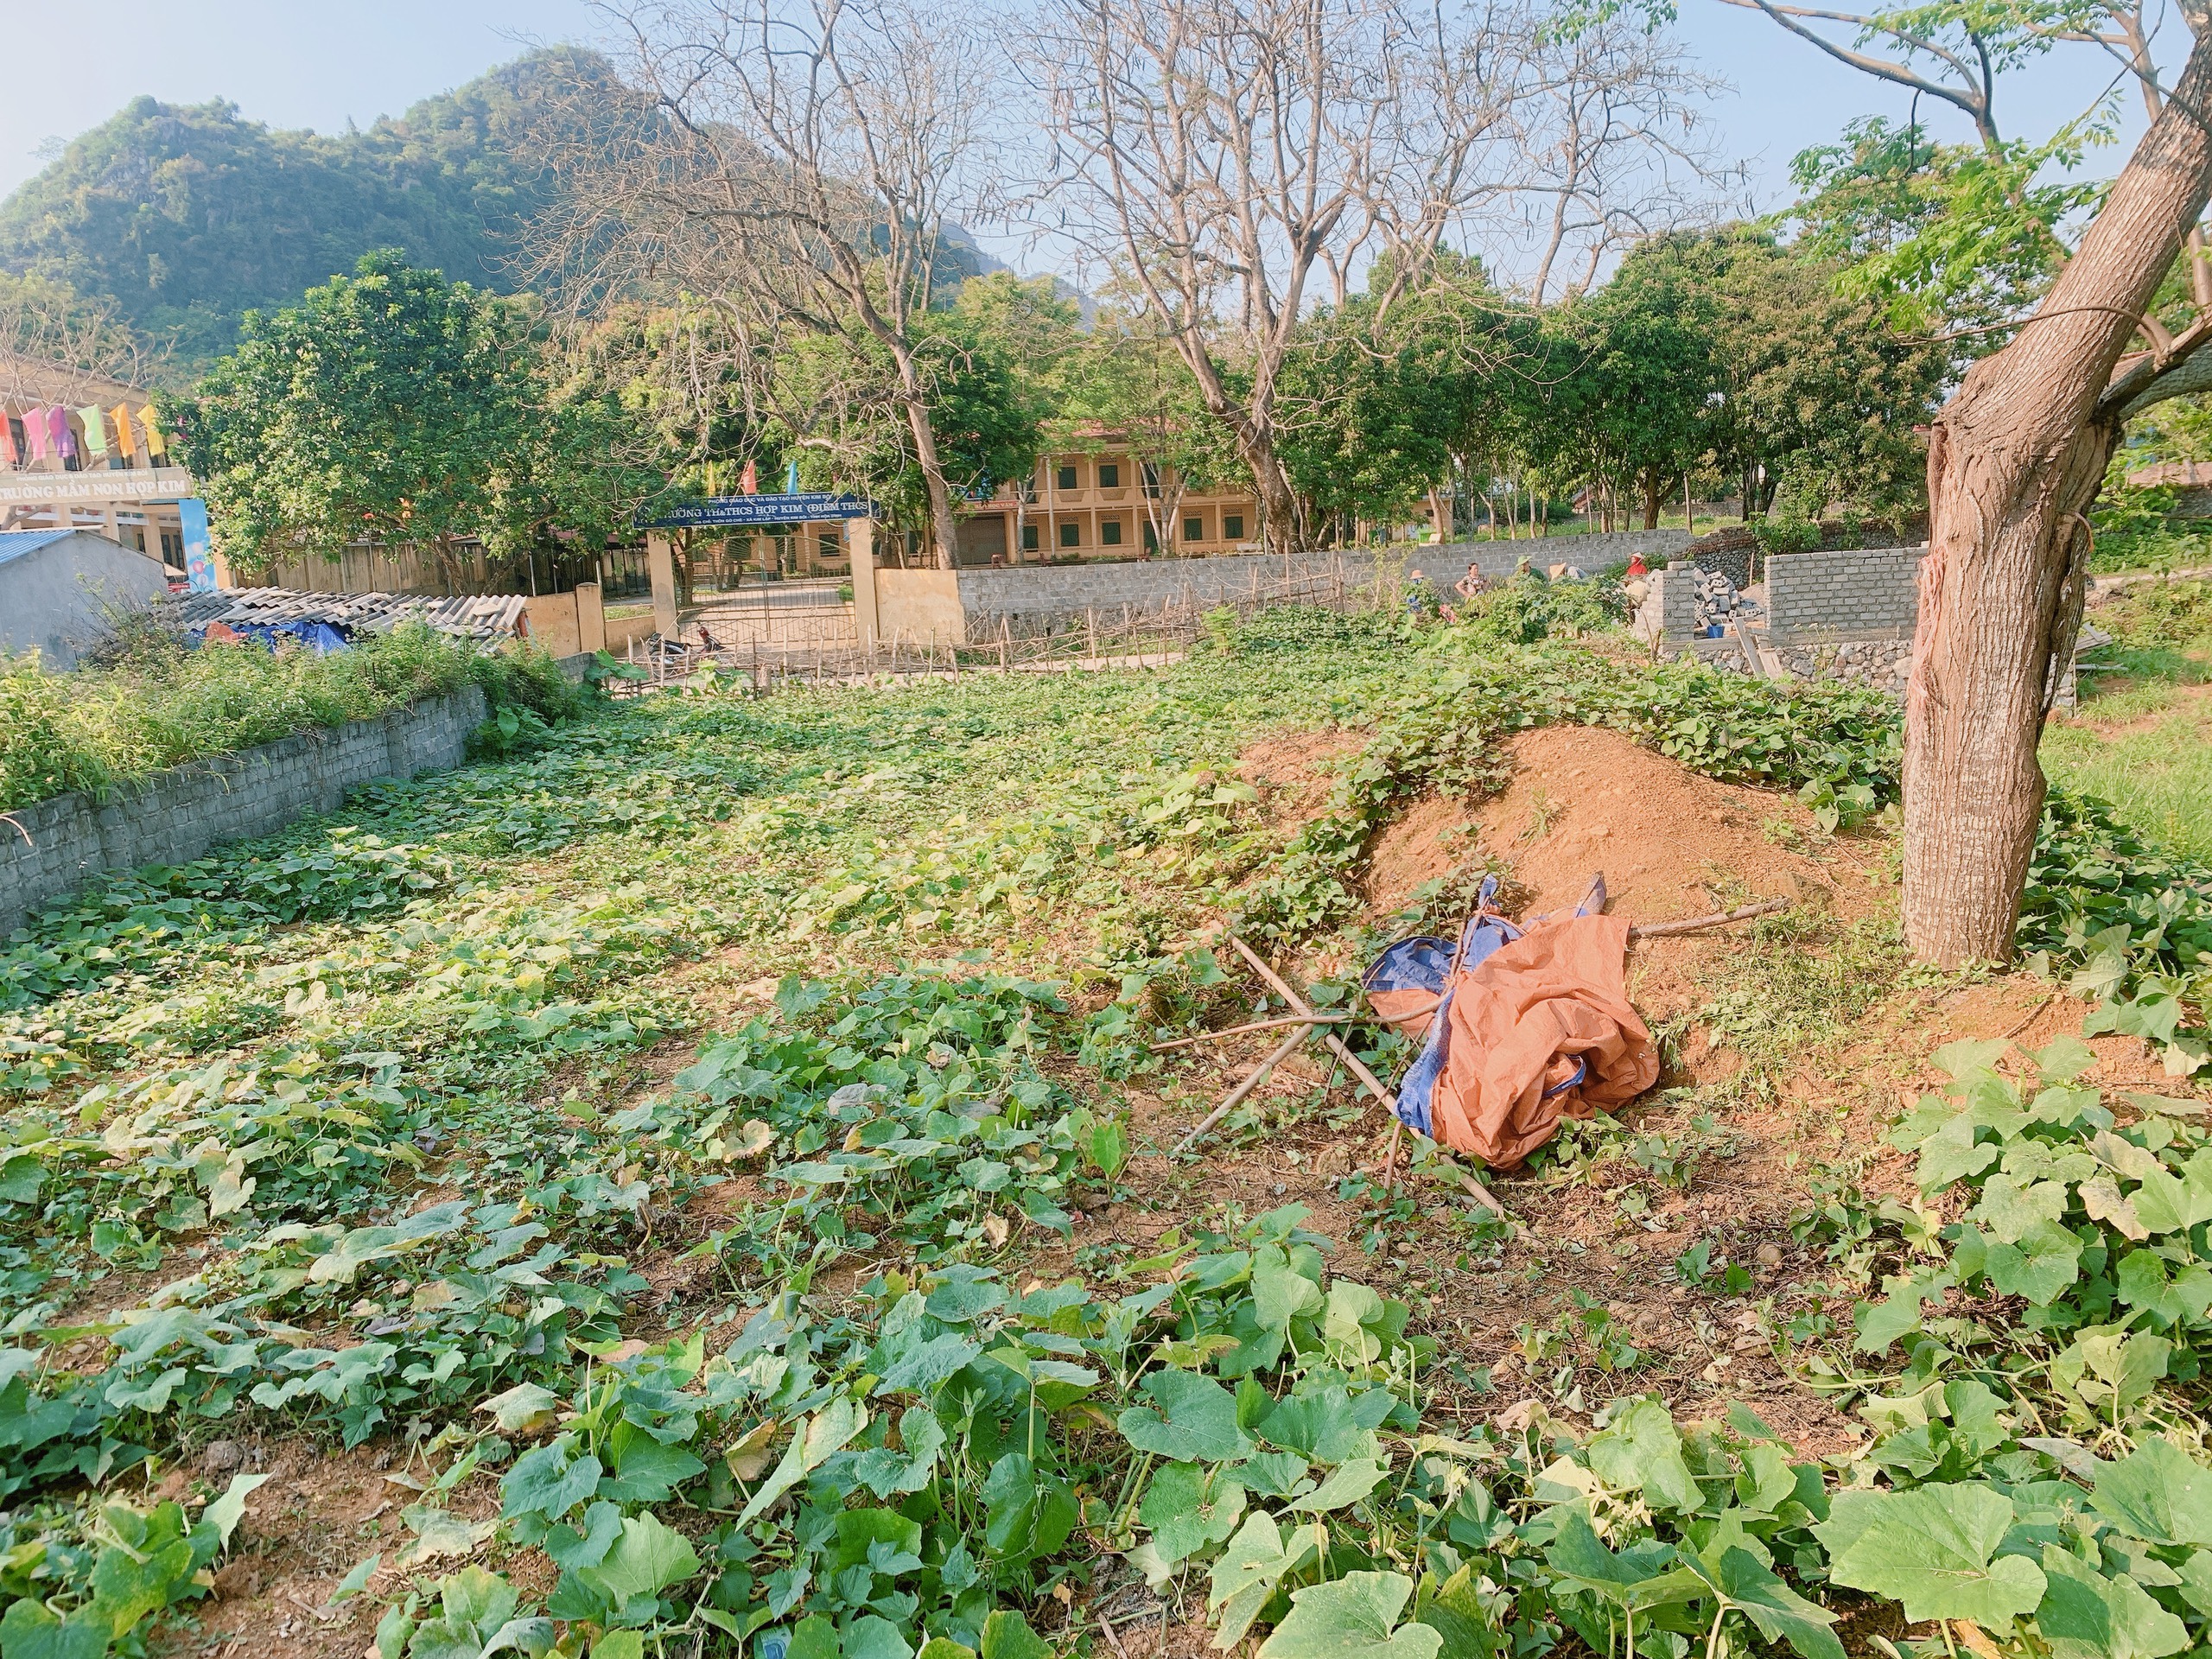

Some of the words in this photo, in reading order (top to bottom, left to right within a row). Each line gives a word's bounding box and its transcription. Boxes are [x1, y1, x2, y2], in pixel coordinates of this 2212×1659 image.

[55, 480, 90, 498] MẦM
[92, 482, 124, 495] NON
[125, 480, 156, 497] HỢP
[157, 480, 186, 493] KIM
[664, 507, 702, 518] ƯỜNG
[780, 504, 802, 513] KIM
